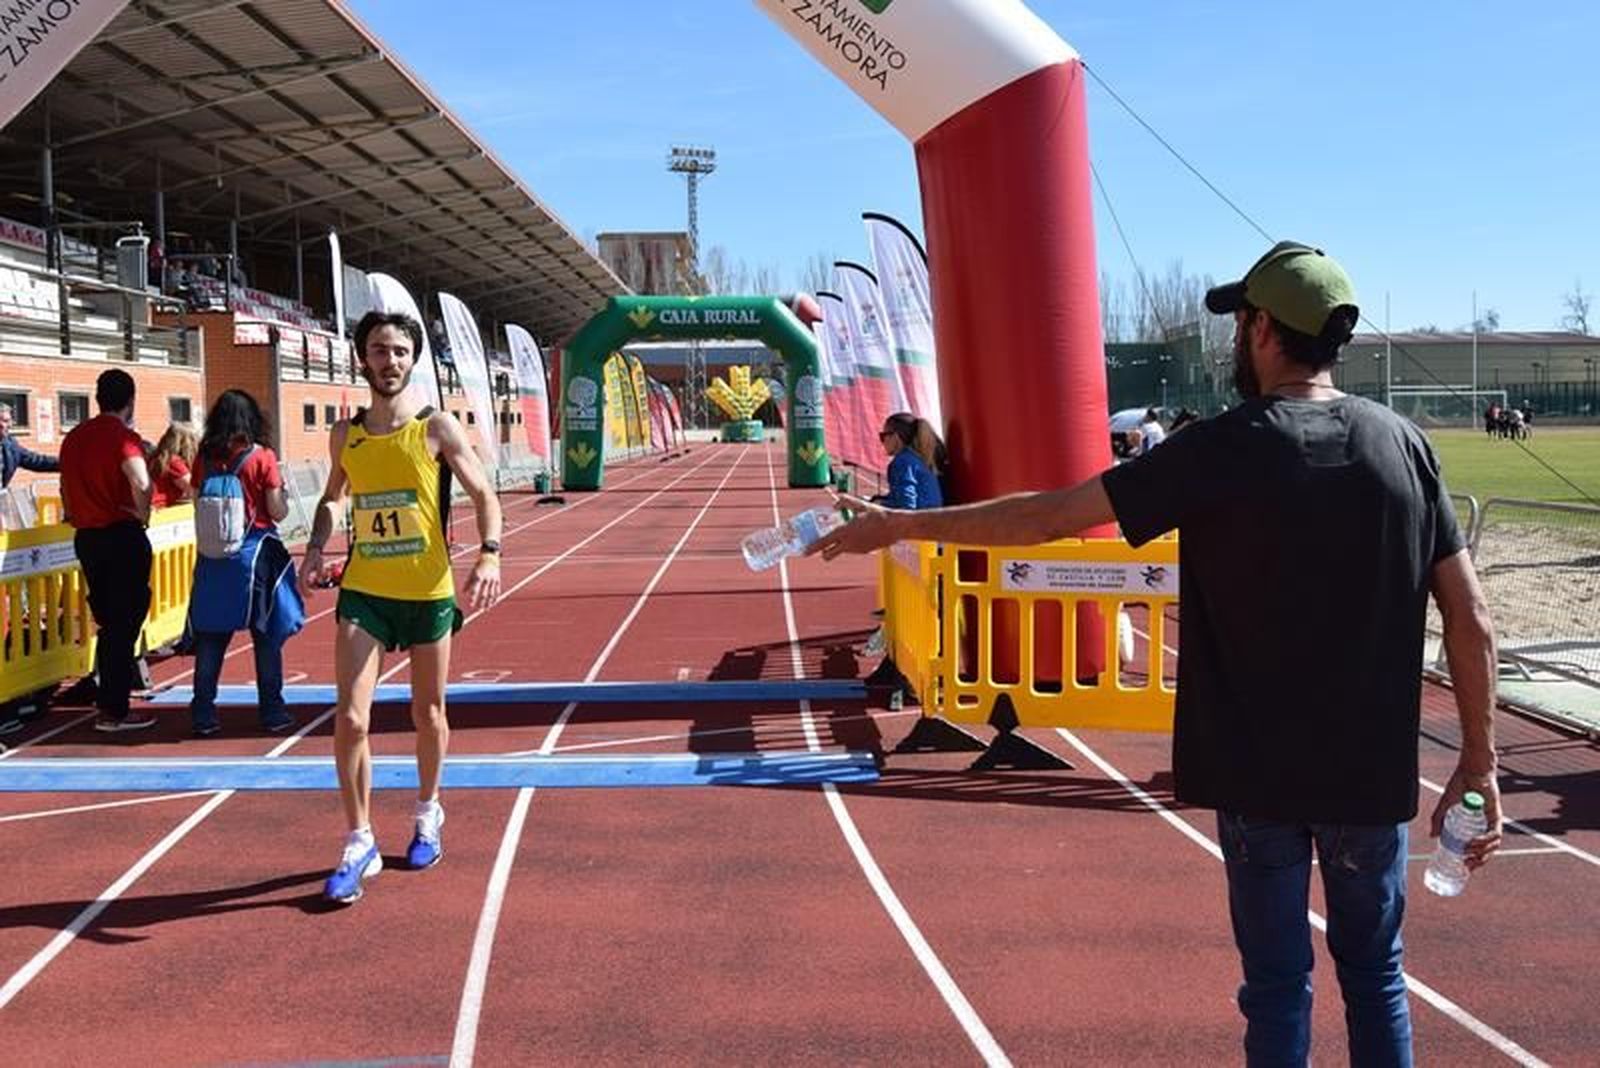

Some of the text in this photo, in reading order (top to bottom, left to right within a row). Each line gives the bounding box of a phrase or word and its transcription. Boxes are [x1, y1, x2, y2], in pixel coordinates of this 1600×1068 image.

[0, 0, 79, 67] ZAMO
[791, 0, 888, 90] ZAMORA
[660, 309, 761, 324] CAJA RURAL
[372, 510, 400, 537] 41
